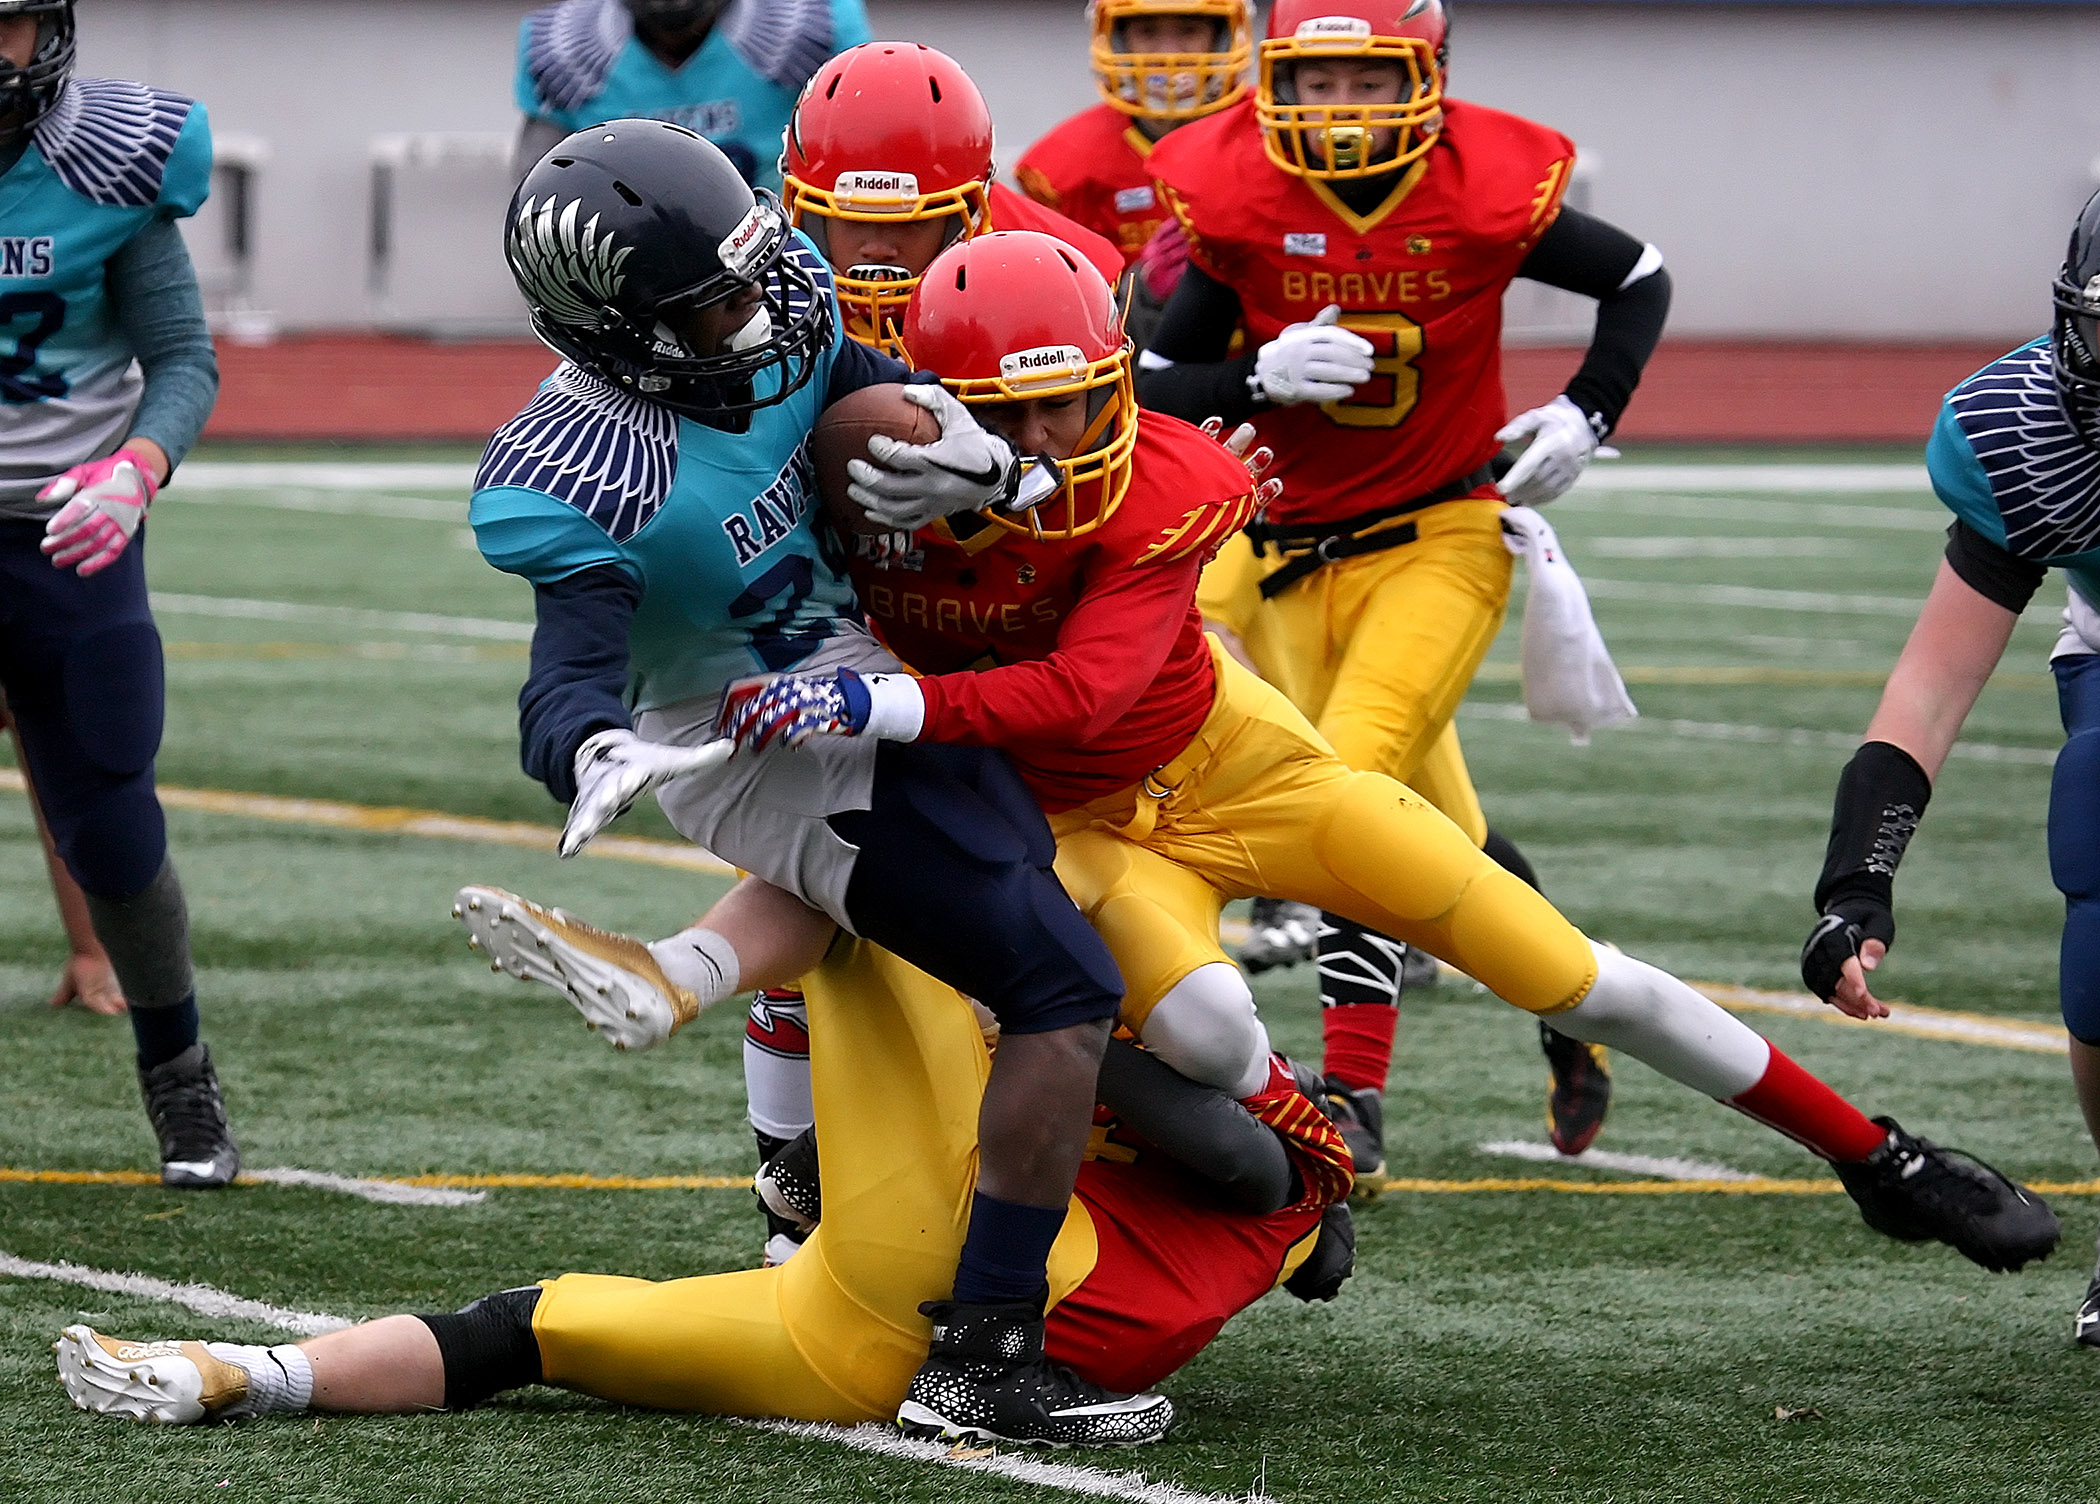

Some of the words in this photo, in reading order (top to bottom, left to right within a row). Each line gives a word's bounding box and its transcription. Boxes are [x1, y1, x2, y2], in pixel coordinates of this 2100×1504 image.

[854, 176, 900, 190] Riddell
[1282, 269, 1451, 303] BRAVES
[1018, 349, 1065, 369] Riddell
[869, 583, 1059, 634] BRAVES
